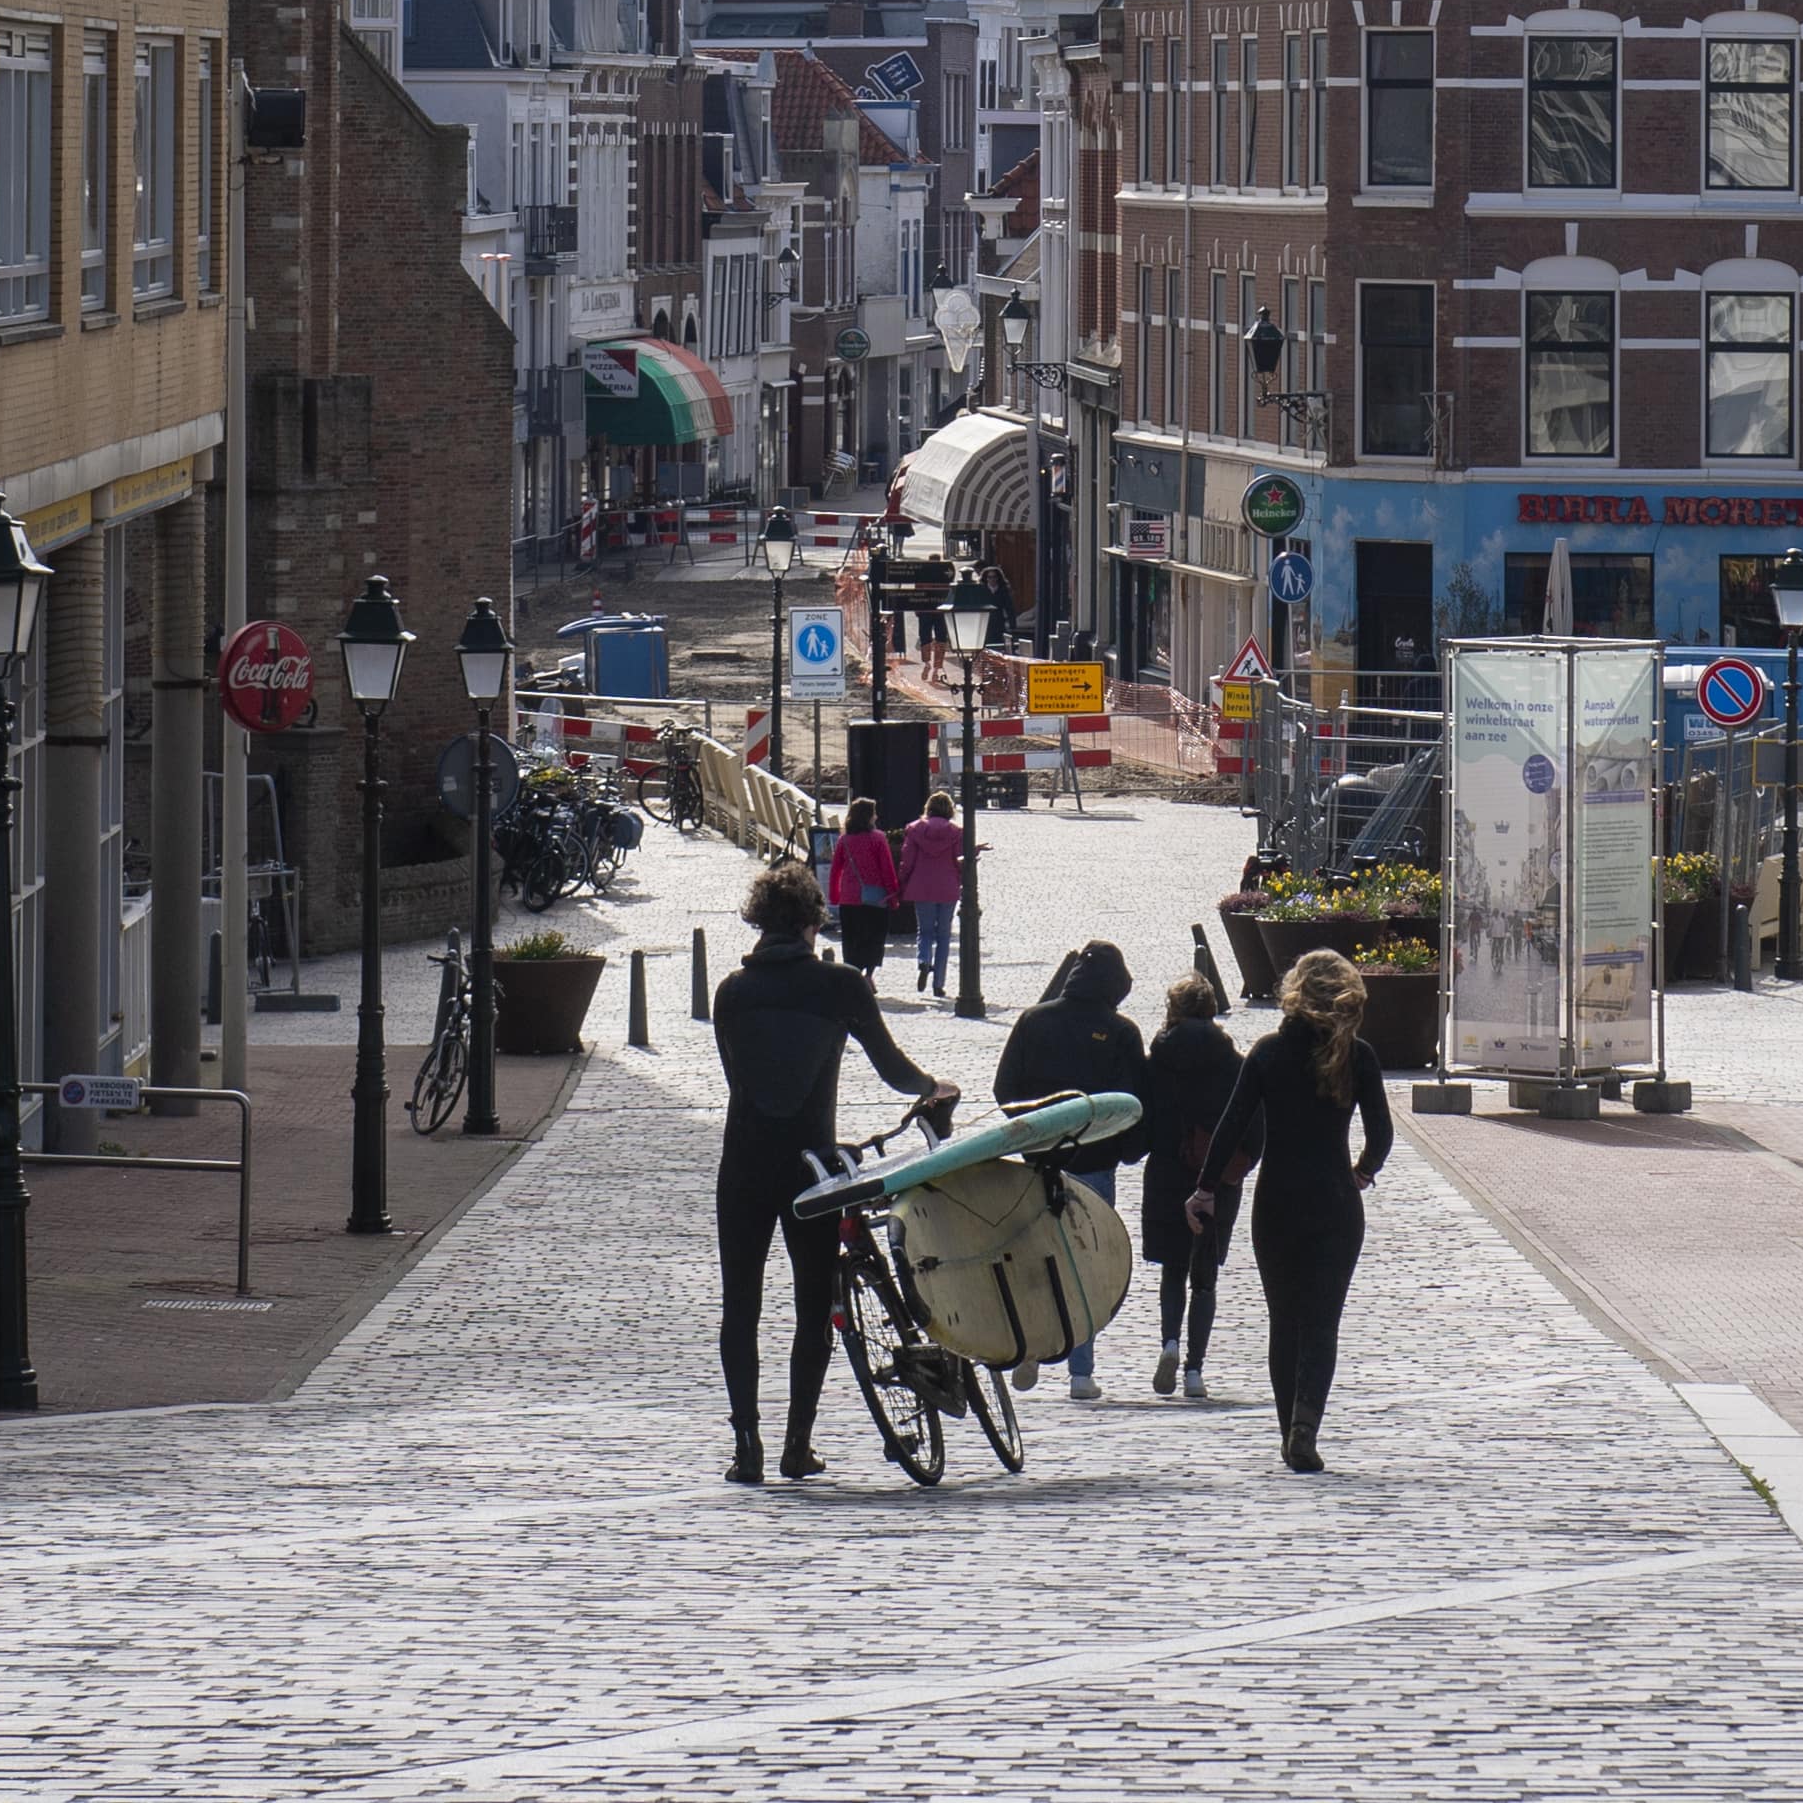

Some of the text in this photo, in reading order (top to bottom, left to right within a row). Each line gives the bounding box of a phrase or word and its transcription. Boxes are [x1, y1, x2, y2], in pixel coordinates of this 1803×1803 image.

[1252, 508, 1297, 518] Heineken
[1517, 493, 1654, 526] BIRRA
[804, 613, 828, 621] ZONE
[1034, 667, 1086, 675] Voetgangers
[1465, 697, 1554, 713] Welkom in onze
[1584, 698, 1616, 713] Aanpak
[1465, 713, 1535, 727] winkelstraat
[1584, 712, 1640, 727] wateroverlast
[1465, 732, 1508, 742] aan zee
[90, 1081, 133, 1090] VERBODEN
[123, 1090, 133, 1098] TE
[90, 1098, 133, 1106] PARKEREN
